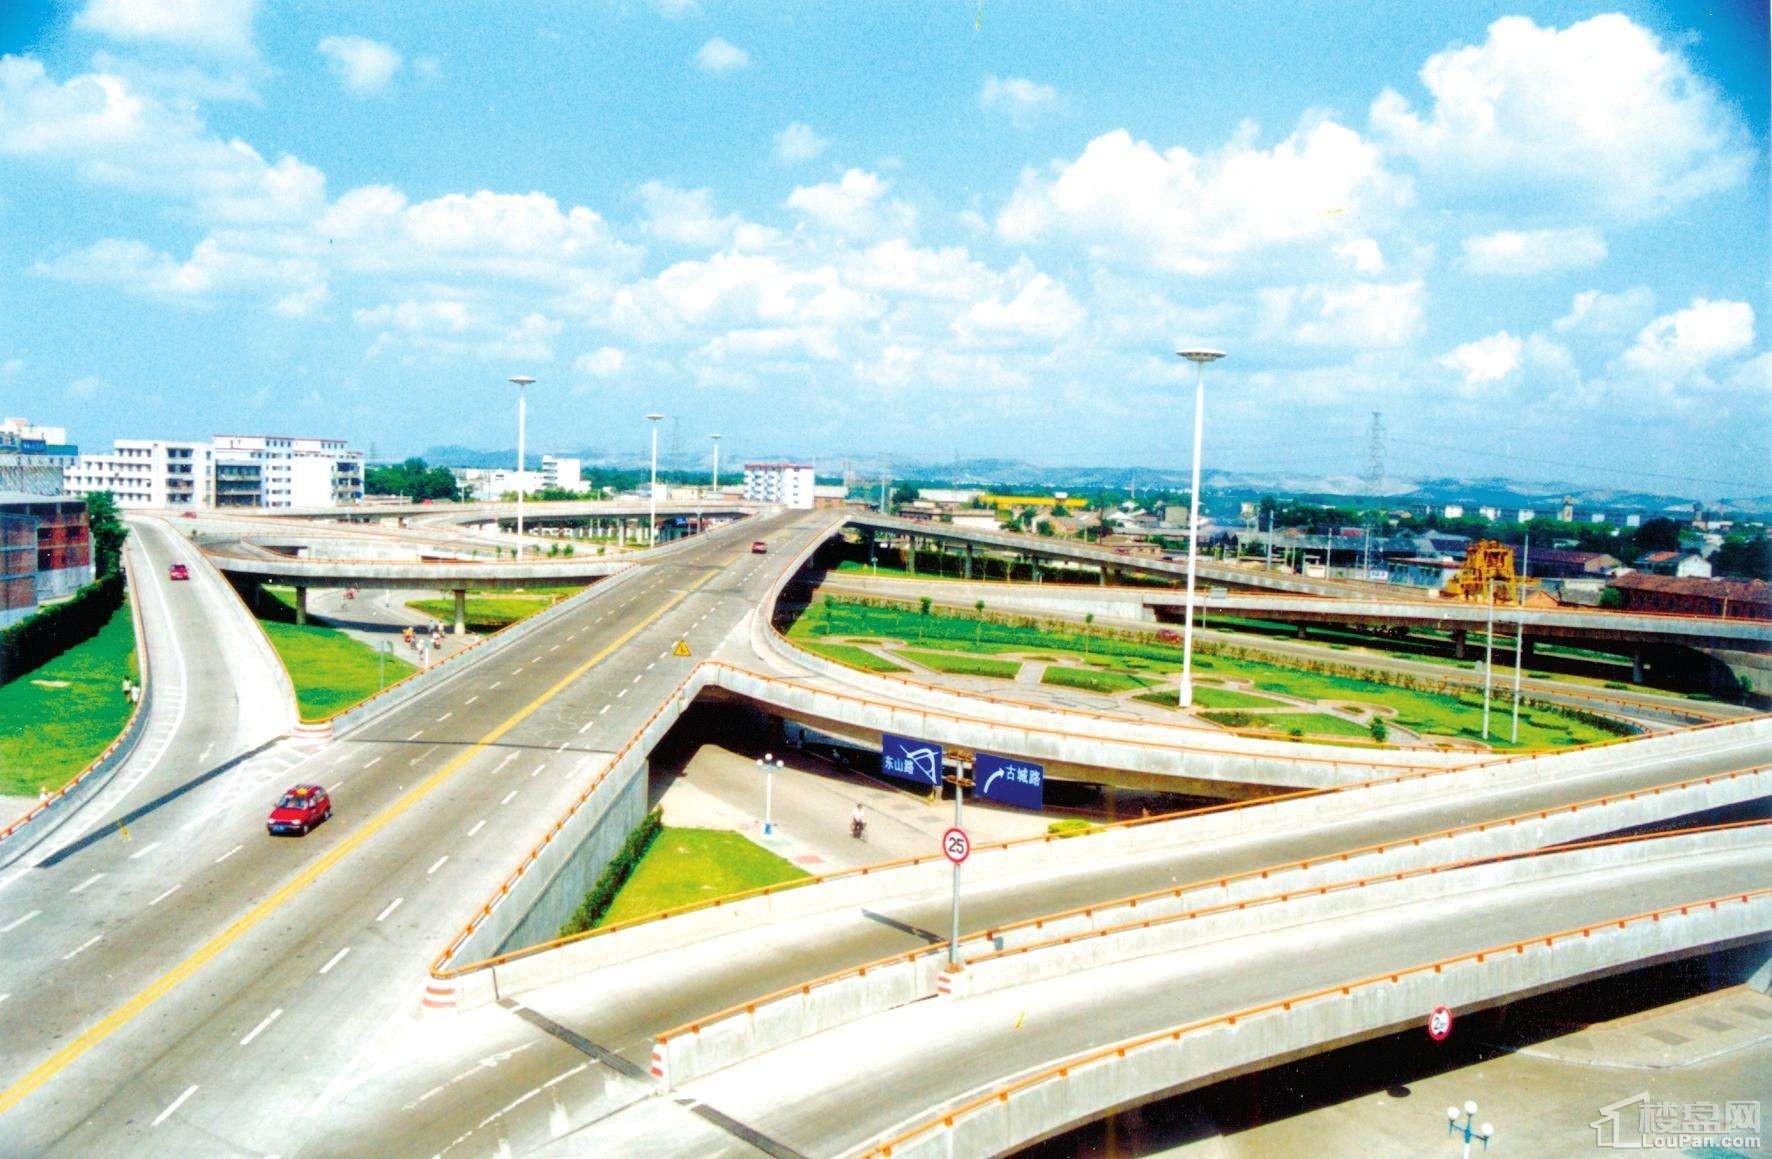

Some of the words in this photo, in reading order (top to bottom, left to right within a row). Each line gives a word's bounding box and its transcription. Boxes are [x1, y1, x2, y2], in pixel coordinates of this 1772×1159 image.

[883, 756, 914, 775] 东山路
[1005, 765, 1041, 787] 古城路
[948, 837, 965, 854] 25
